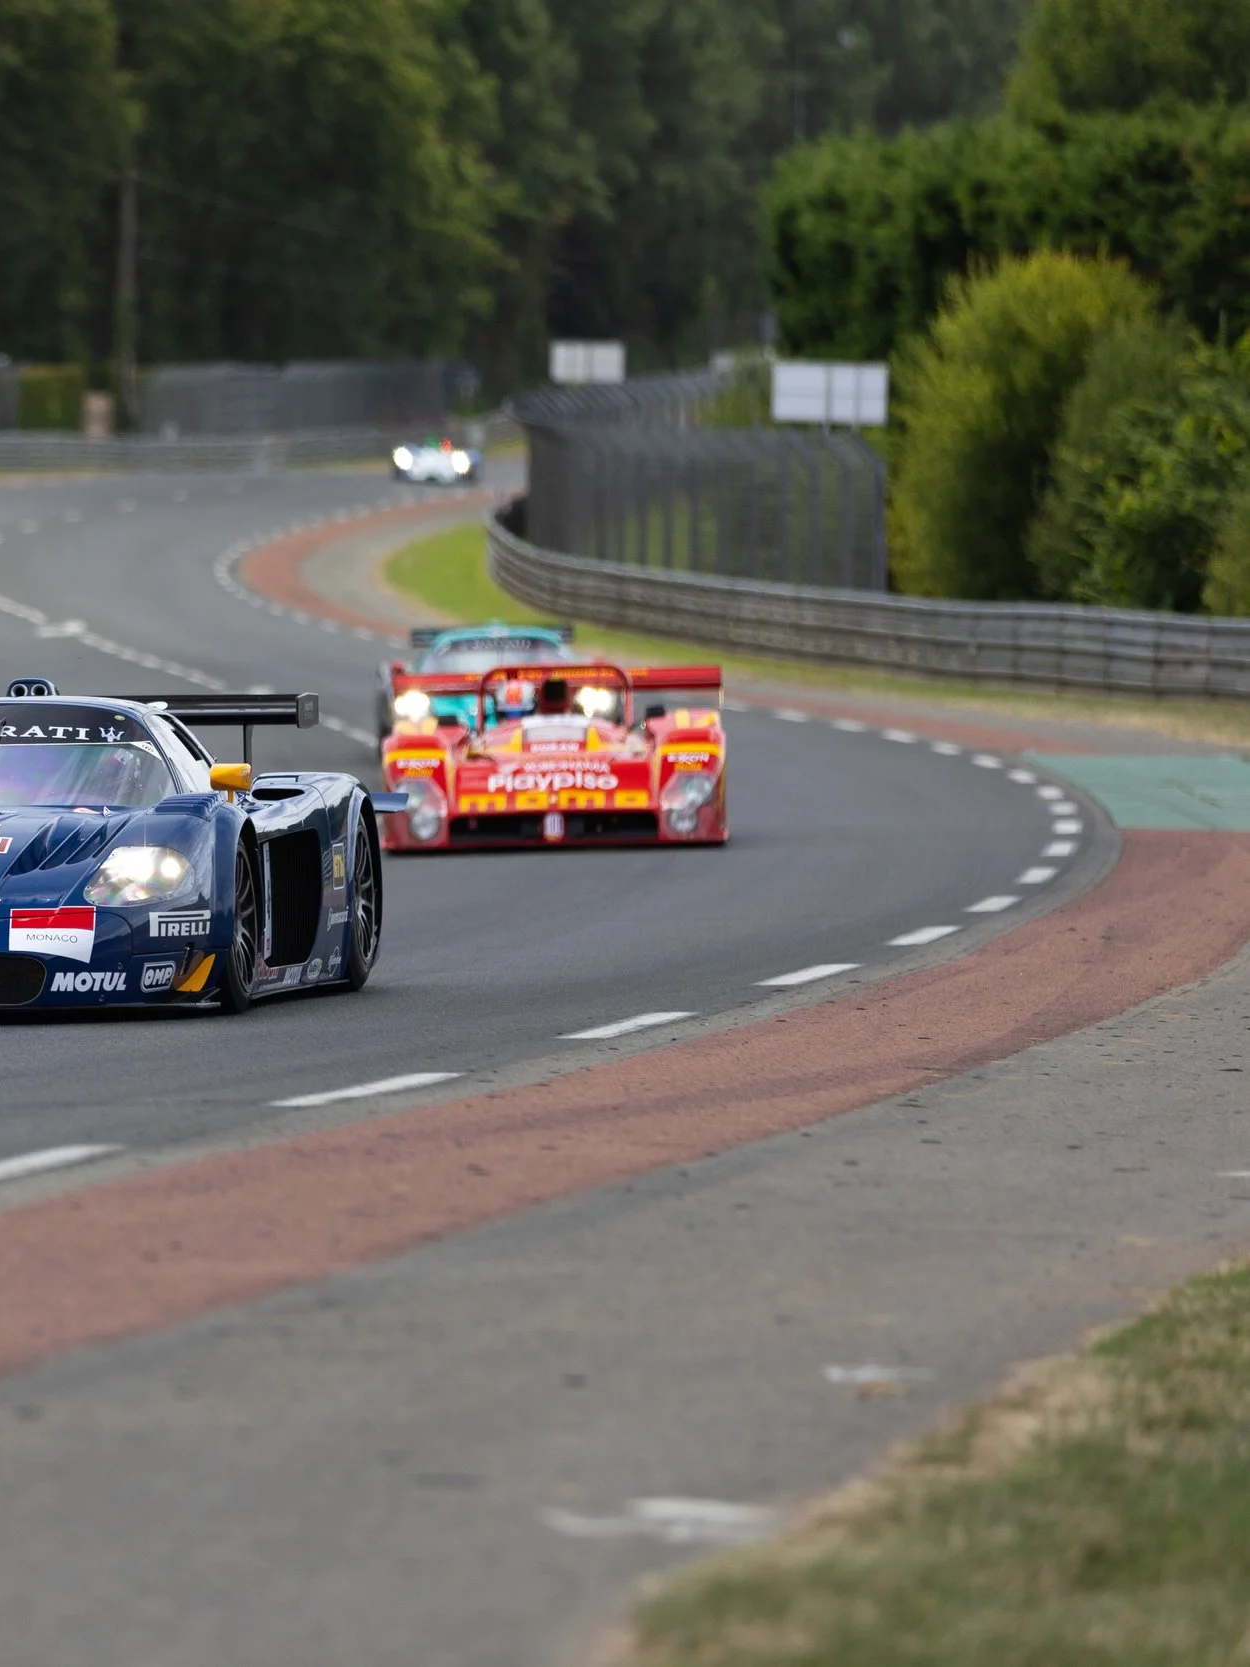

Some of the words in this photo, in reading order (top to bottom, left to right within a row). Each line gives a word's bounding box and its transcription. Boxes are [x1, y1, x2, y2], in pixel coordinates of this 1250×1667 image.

[149, 910, 212, 937] PIRELLI
[26, 933, 79, 944] MONACO
[50, 972, 127, 992] MOTUL
[144, 967, 173, 990] OMP
